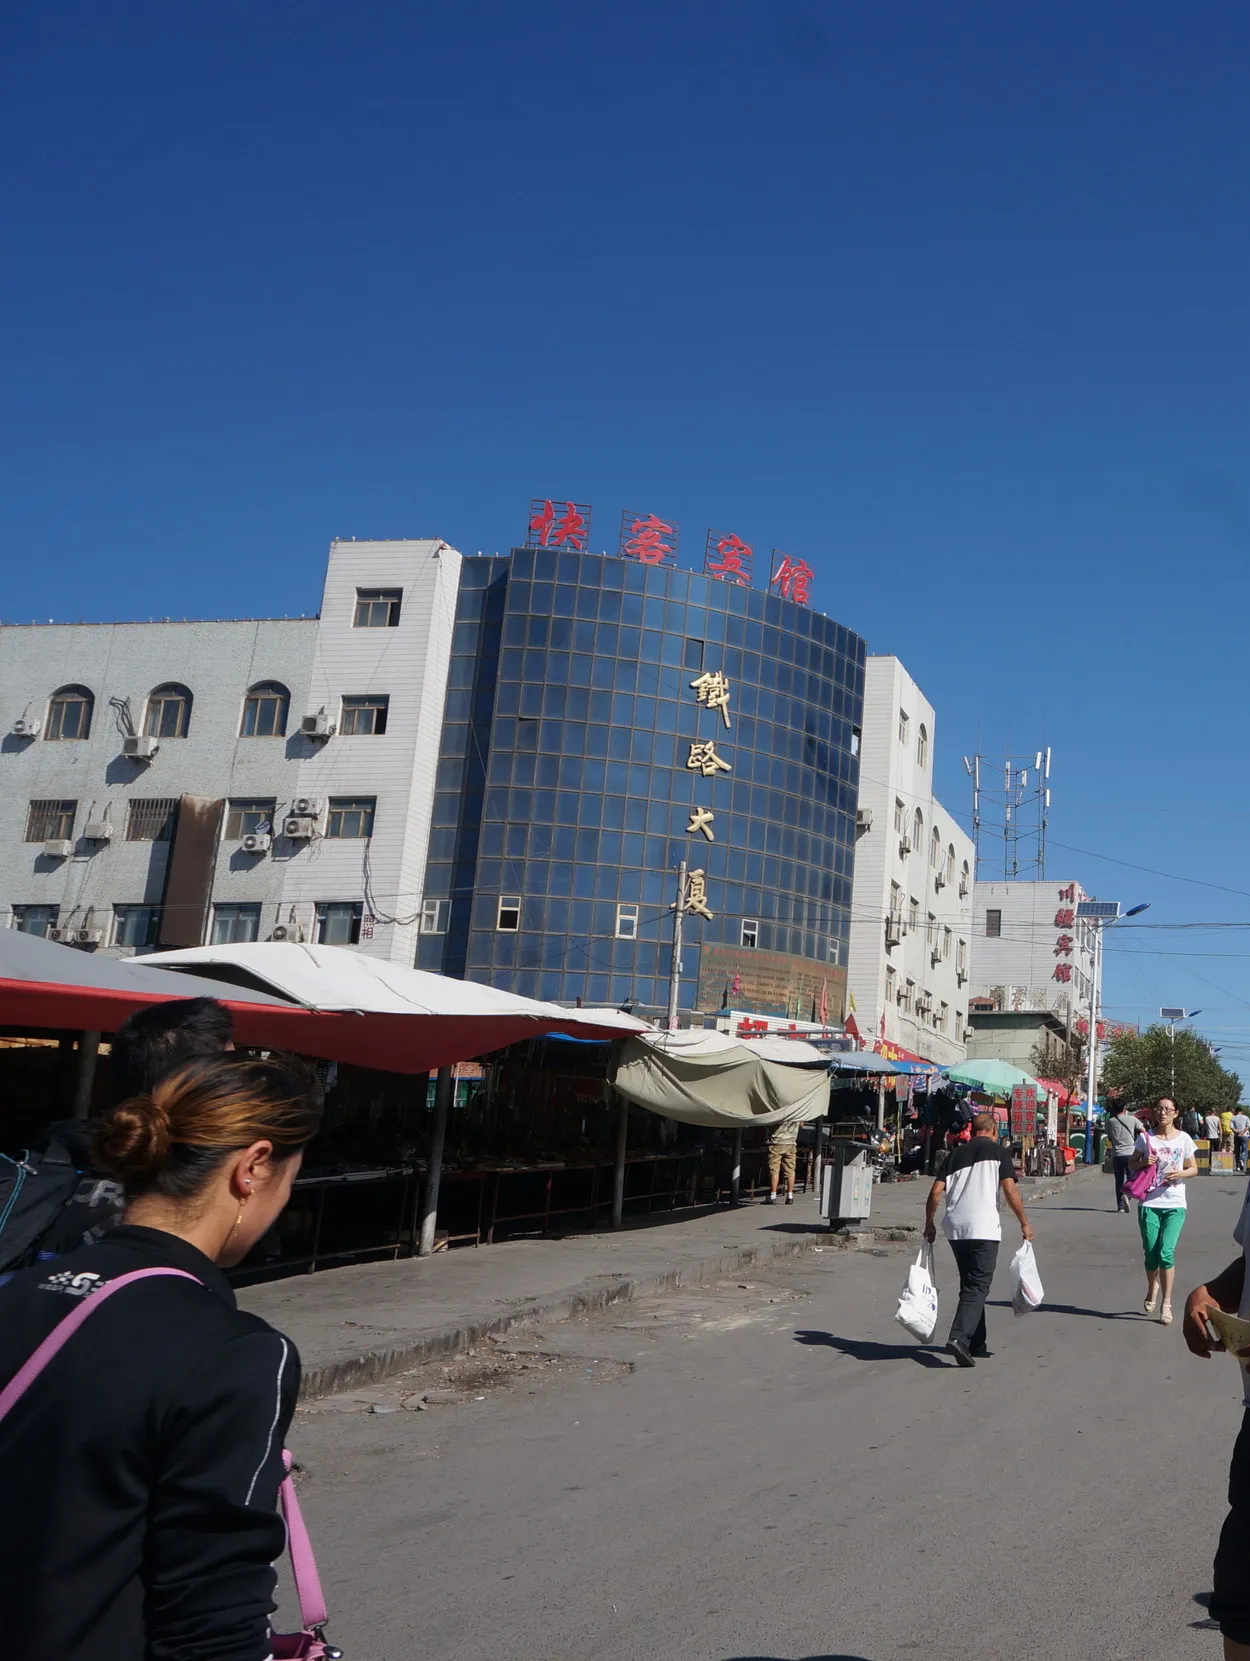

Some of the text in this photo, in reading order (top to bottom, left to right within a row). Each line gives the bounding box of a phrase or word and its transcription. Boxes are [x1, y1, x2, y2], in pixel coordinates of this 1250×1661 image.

[529, 499, 815, 605] 快客宾馆
[1012, 1088, 1024, 1134] 专修箱包
[1024, 1087, 1036, 1133] 欢迎寄存
